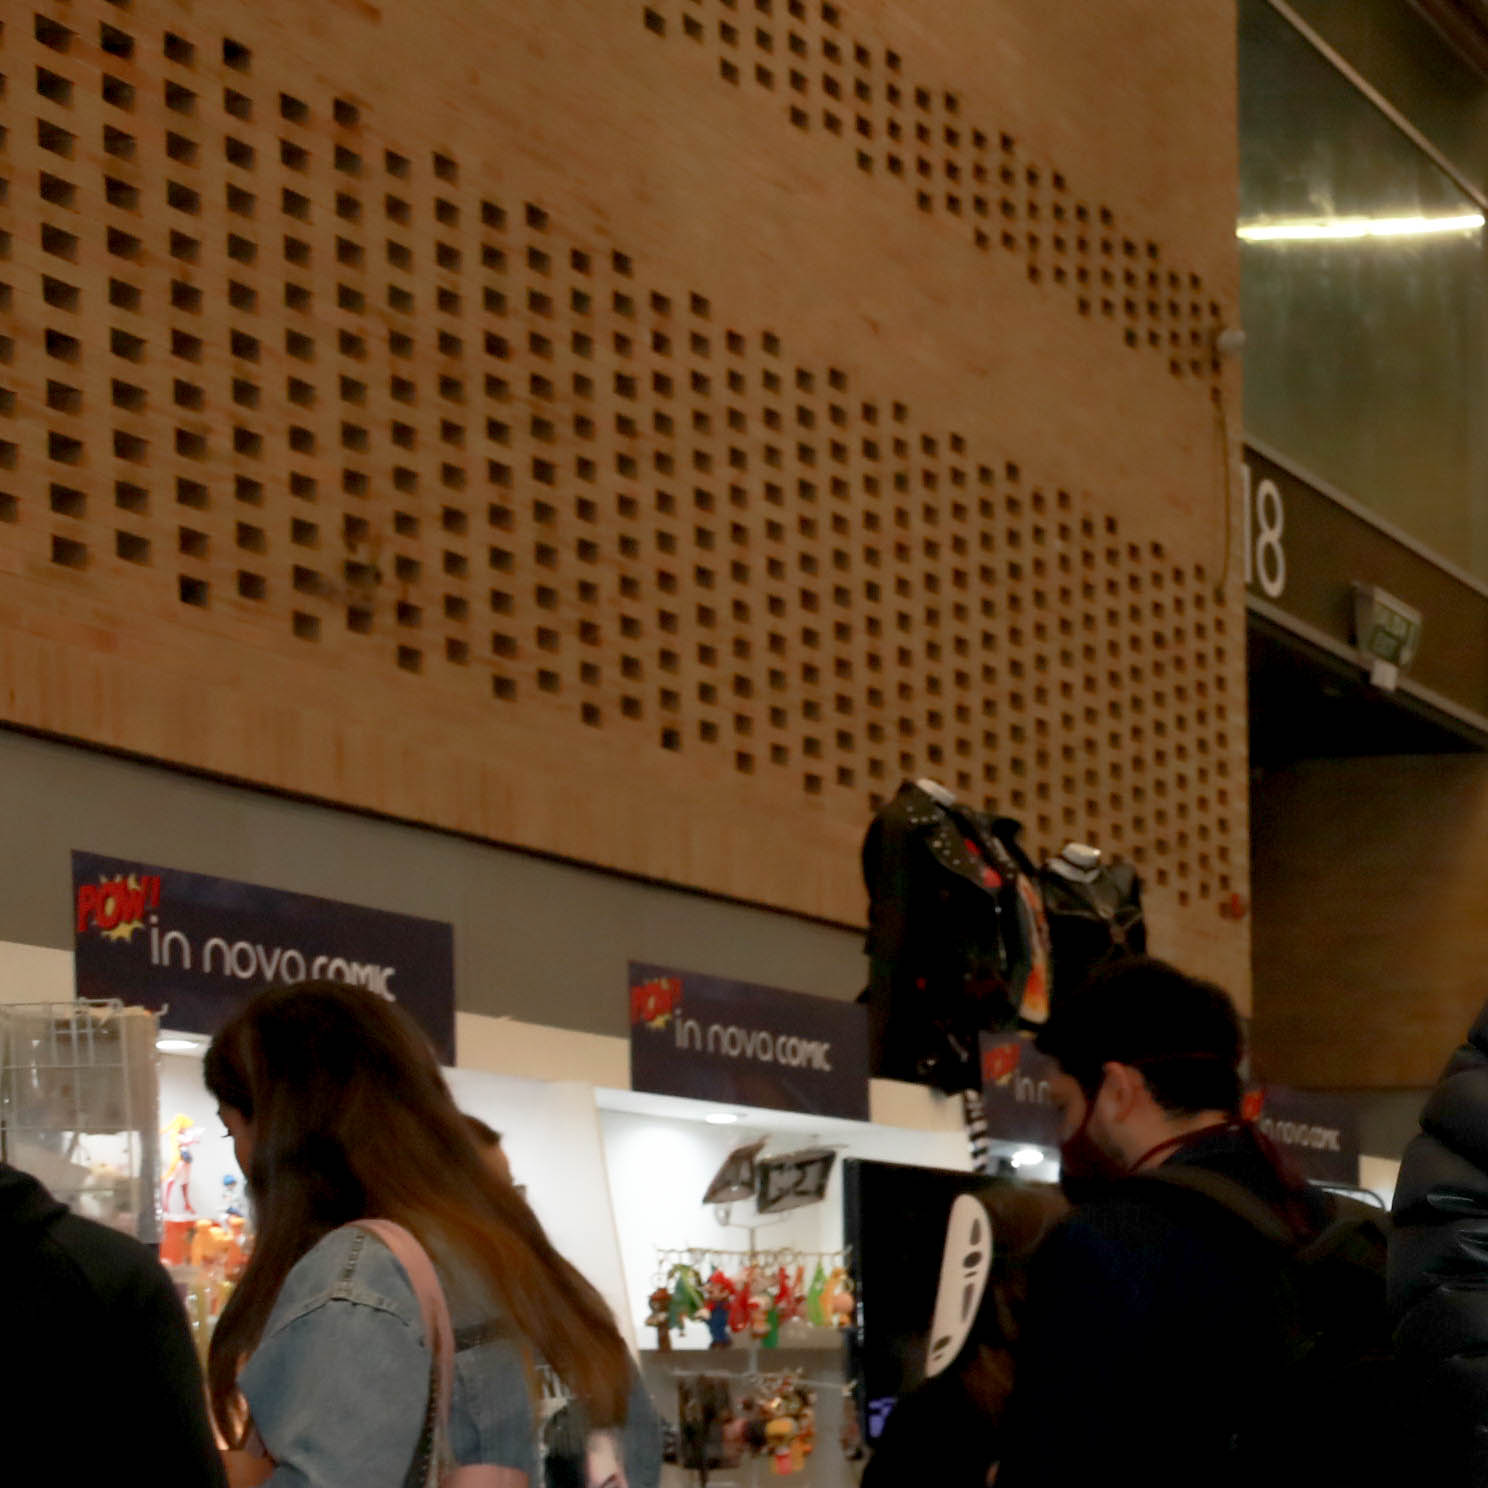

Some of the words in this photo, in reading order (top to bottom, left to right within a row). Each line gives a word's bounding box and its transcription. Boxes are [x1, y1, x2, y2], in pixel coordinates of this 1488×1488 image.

[1240, 463, 1286, 598] 18
[150, 914, 190, 970] in
[203, 936, 306, 985] nova
[674, 1008, 701, 1051] in
[707, 1023, 774, 1062] nova
